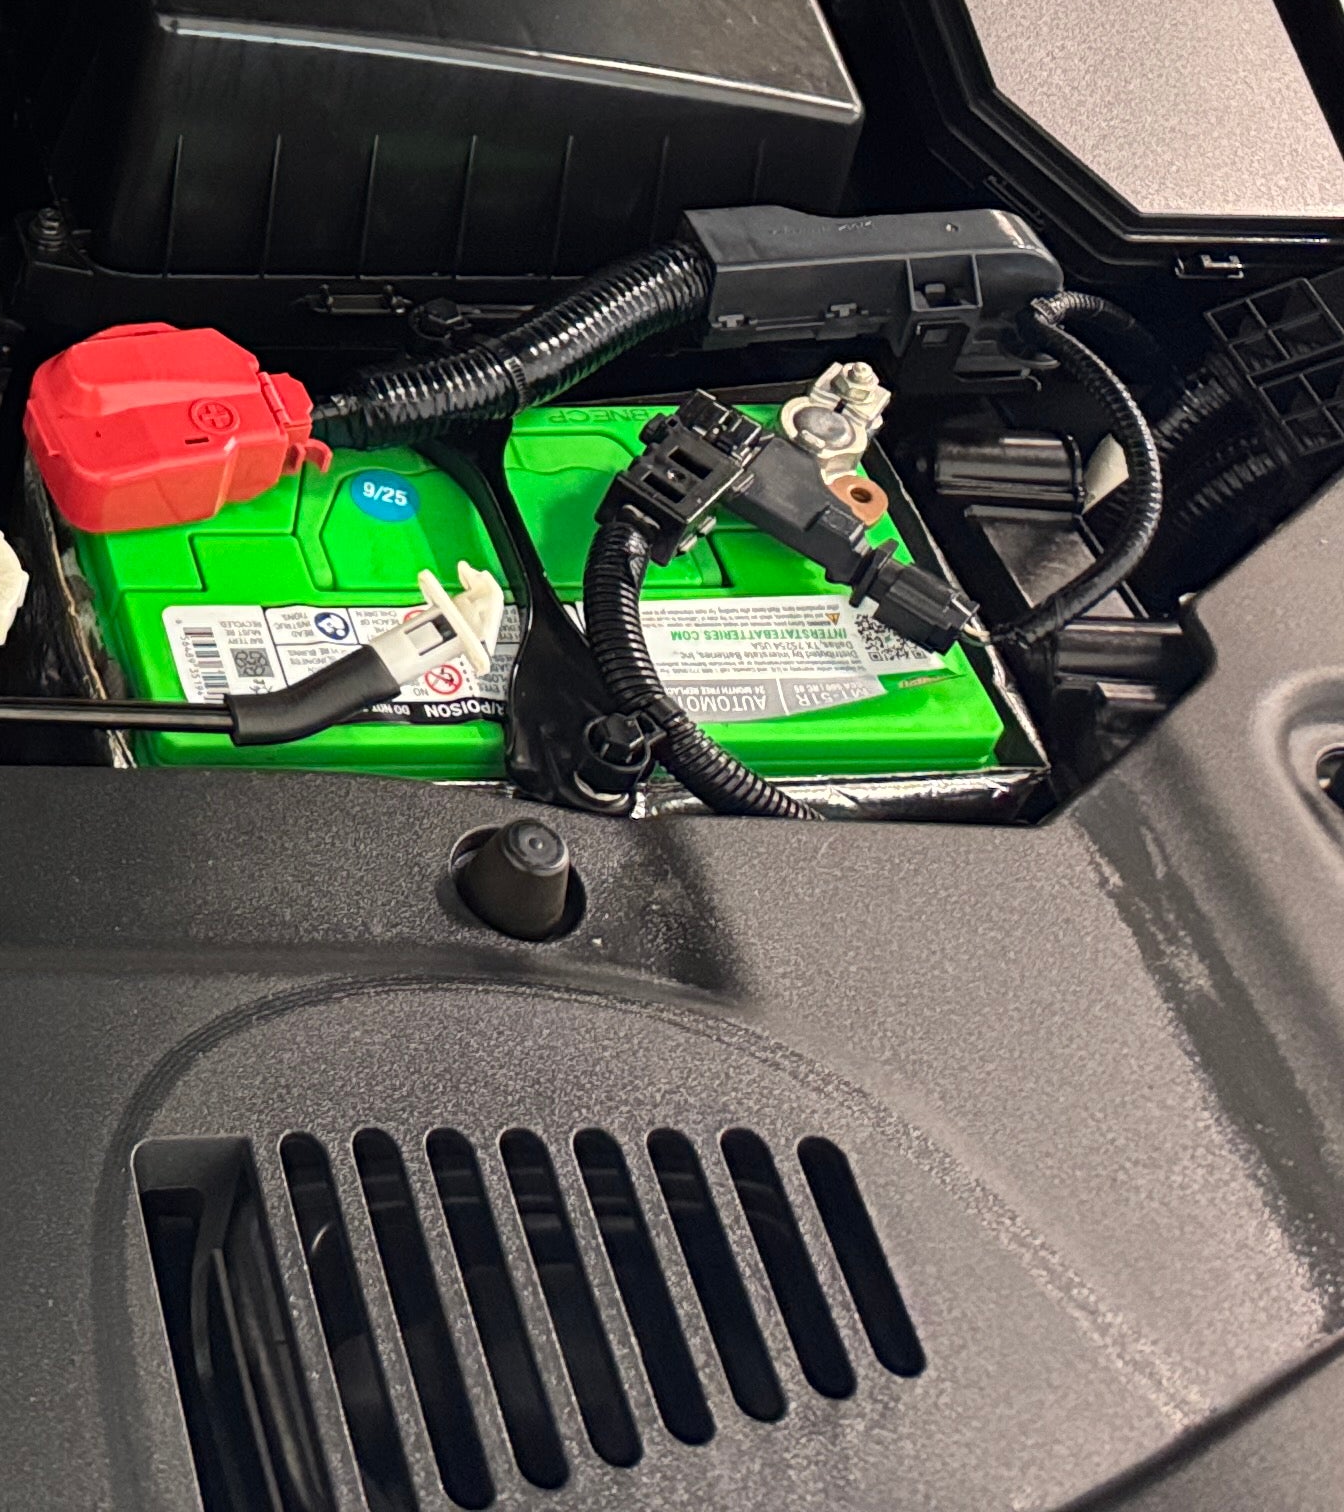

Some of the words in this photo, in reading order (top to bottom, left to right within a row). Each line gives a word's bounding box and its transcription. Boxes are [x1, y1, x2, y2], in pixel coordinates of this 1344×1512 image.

[362, 481, 408, 507] 9/25
[750, 641, 772, 650] USA
[412, 687, 429, 697] NO
[393, 704, 411, 716] DO
